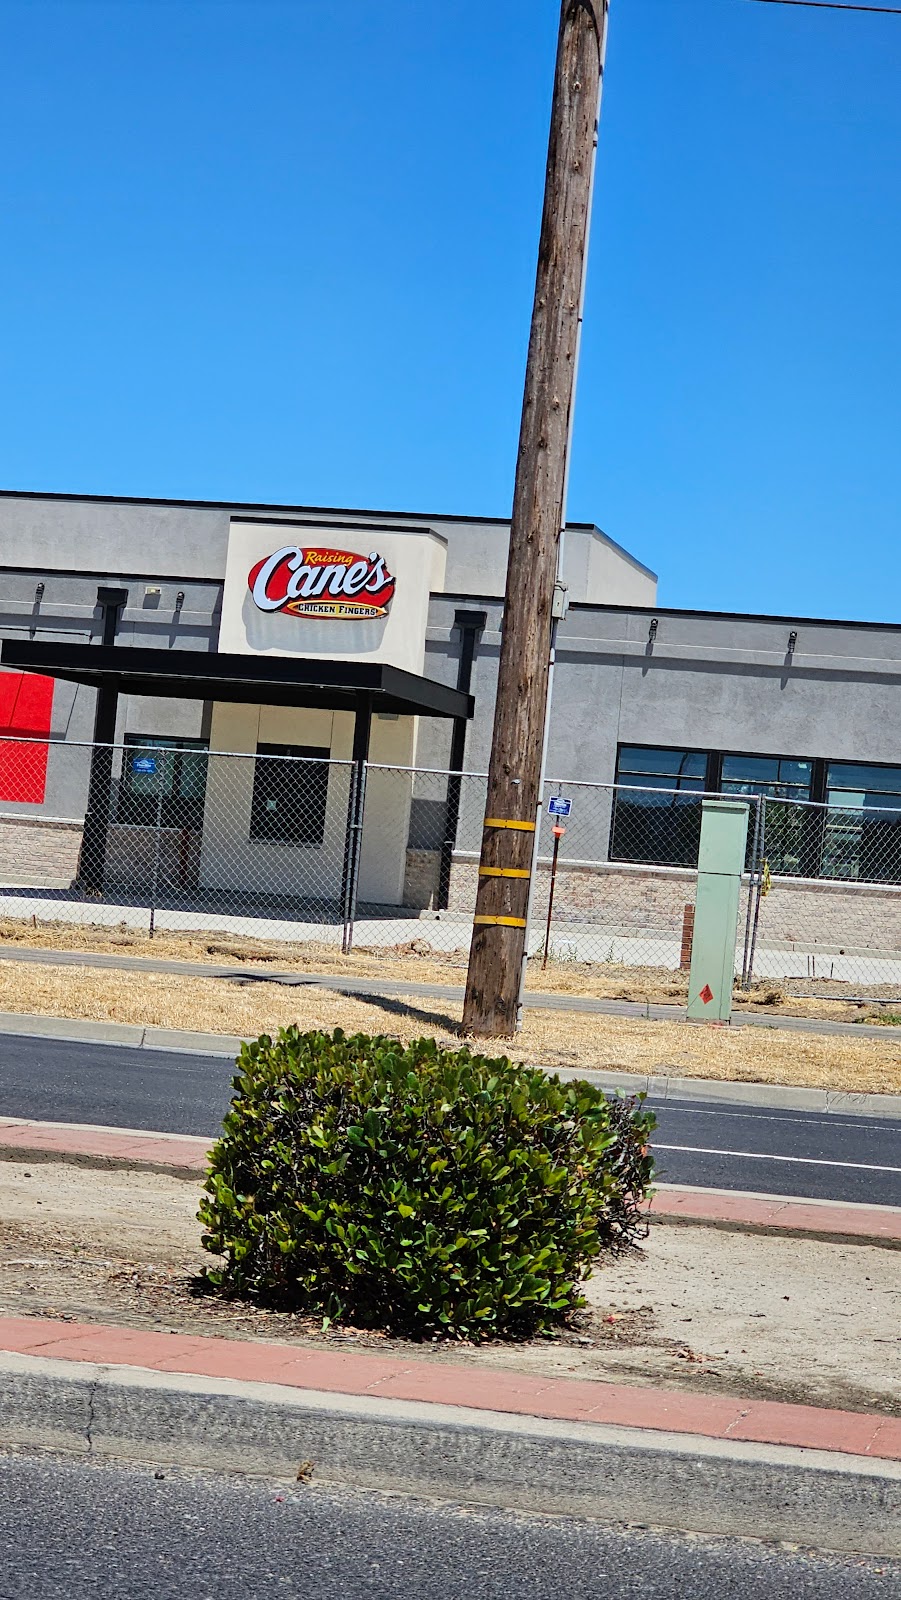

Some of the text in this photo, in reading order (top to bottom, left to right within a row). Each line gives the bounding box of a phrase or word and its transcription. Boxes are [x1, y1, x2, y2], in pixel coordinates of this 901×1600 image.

[304, 551, 354, 566] Raising
[253, 545, 395, 611] Cane's
[298, 603, 377, 616] CHICKEN FINGERS
